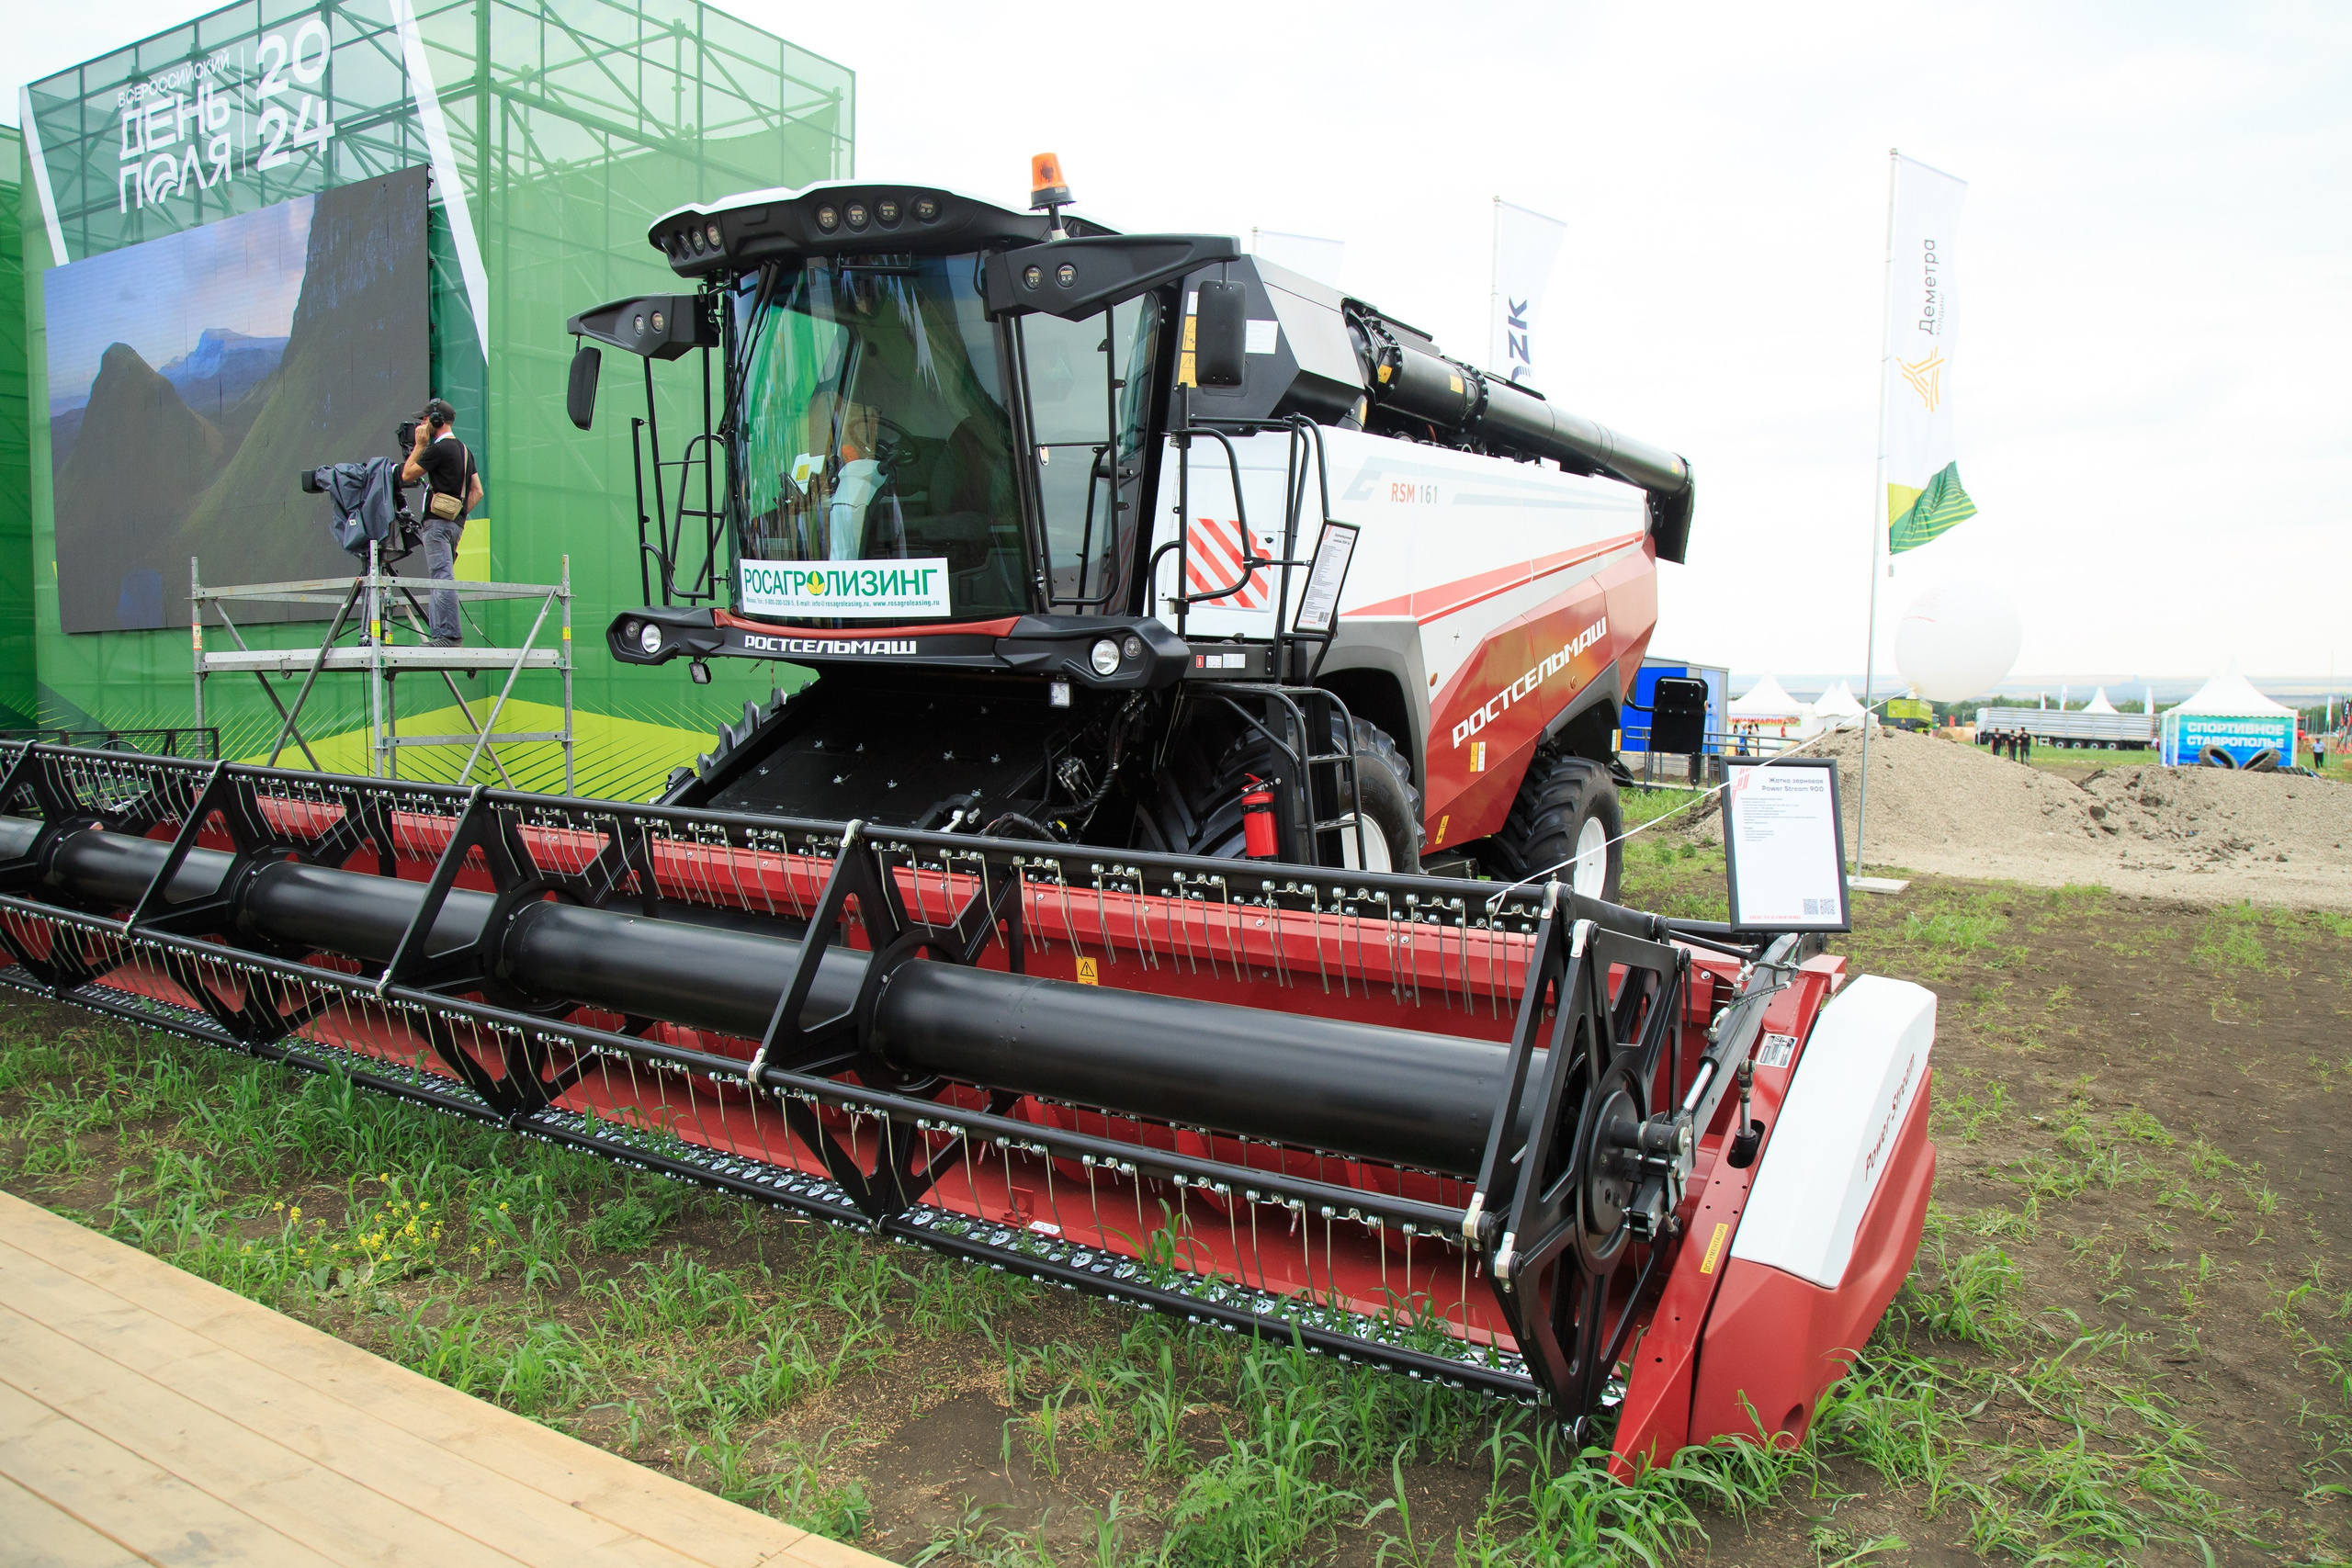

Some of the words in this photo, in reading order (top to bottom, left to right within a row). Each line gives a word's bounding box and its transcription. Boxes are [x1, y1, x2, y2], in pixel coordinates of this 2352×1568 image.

[118, 49, 230, 107] ВСЕРОССИЙСКИЙ
[255, 19, 331, 100] 20
[119, 83, 231, 161] ДЕНЬ
[256, 95, 335, 172] 24
[119, 132, 232, 214] ПОЛЯ
[1919, 239, 1939, 334] Деметра
[1391, 482, 1415, 503] RSM
[1420, 485, 1438, 504] 161
[743, 568, 938, 597] РОСАГРОЛИЗИНГ
[873, 599, 940, 607] www.rosagroleasing.ru
[744, 634, 917, 655] РОСТСЕЛЬМАШ
[1452, 616, 1607, 750] РОСТСЕЛЬМАШ
[2186, 736, 2285, 749] СТАВРОПОЛЬЕ
[2187, 722, 2285, 736] СПОРТИВНОЕ
[1865, 1113, 1891, 1182] Power
[1891, 1053, 1915, 1122] Stream
[1703, 1224, 1725, 1272] ДОКУМЕНТАЦИЯ
